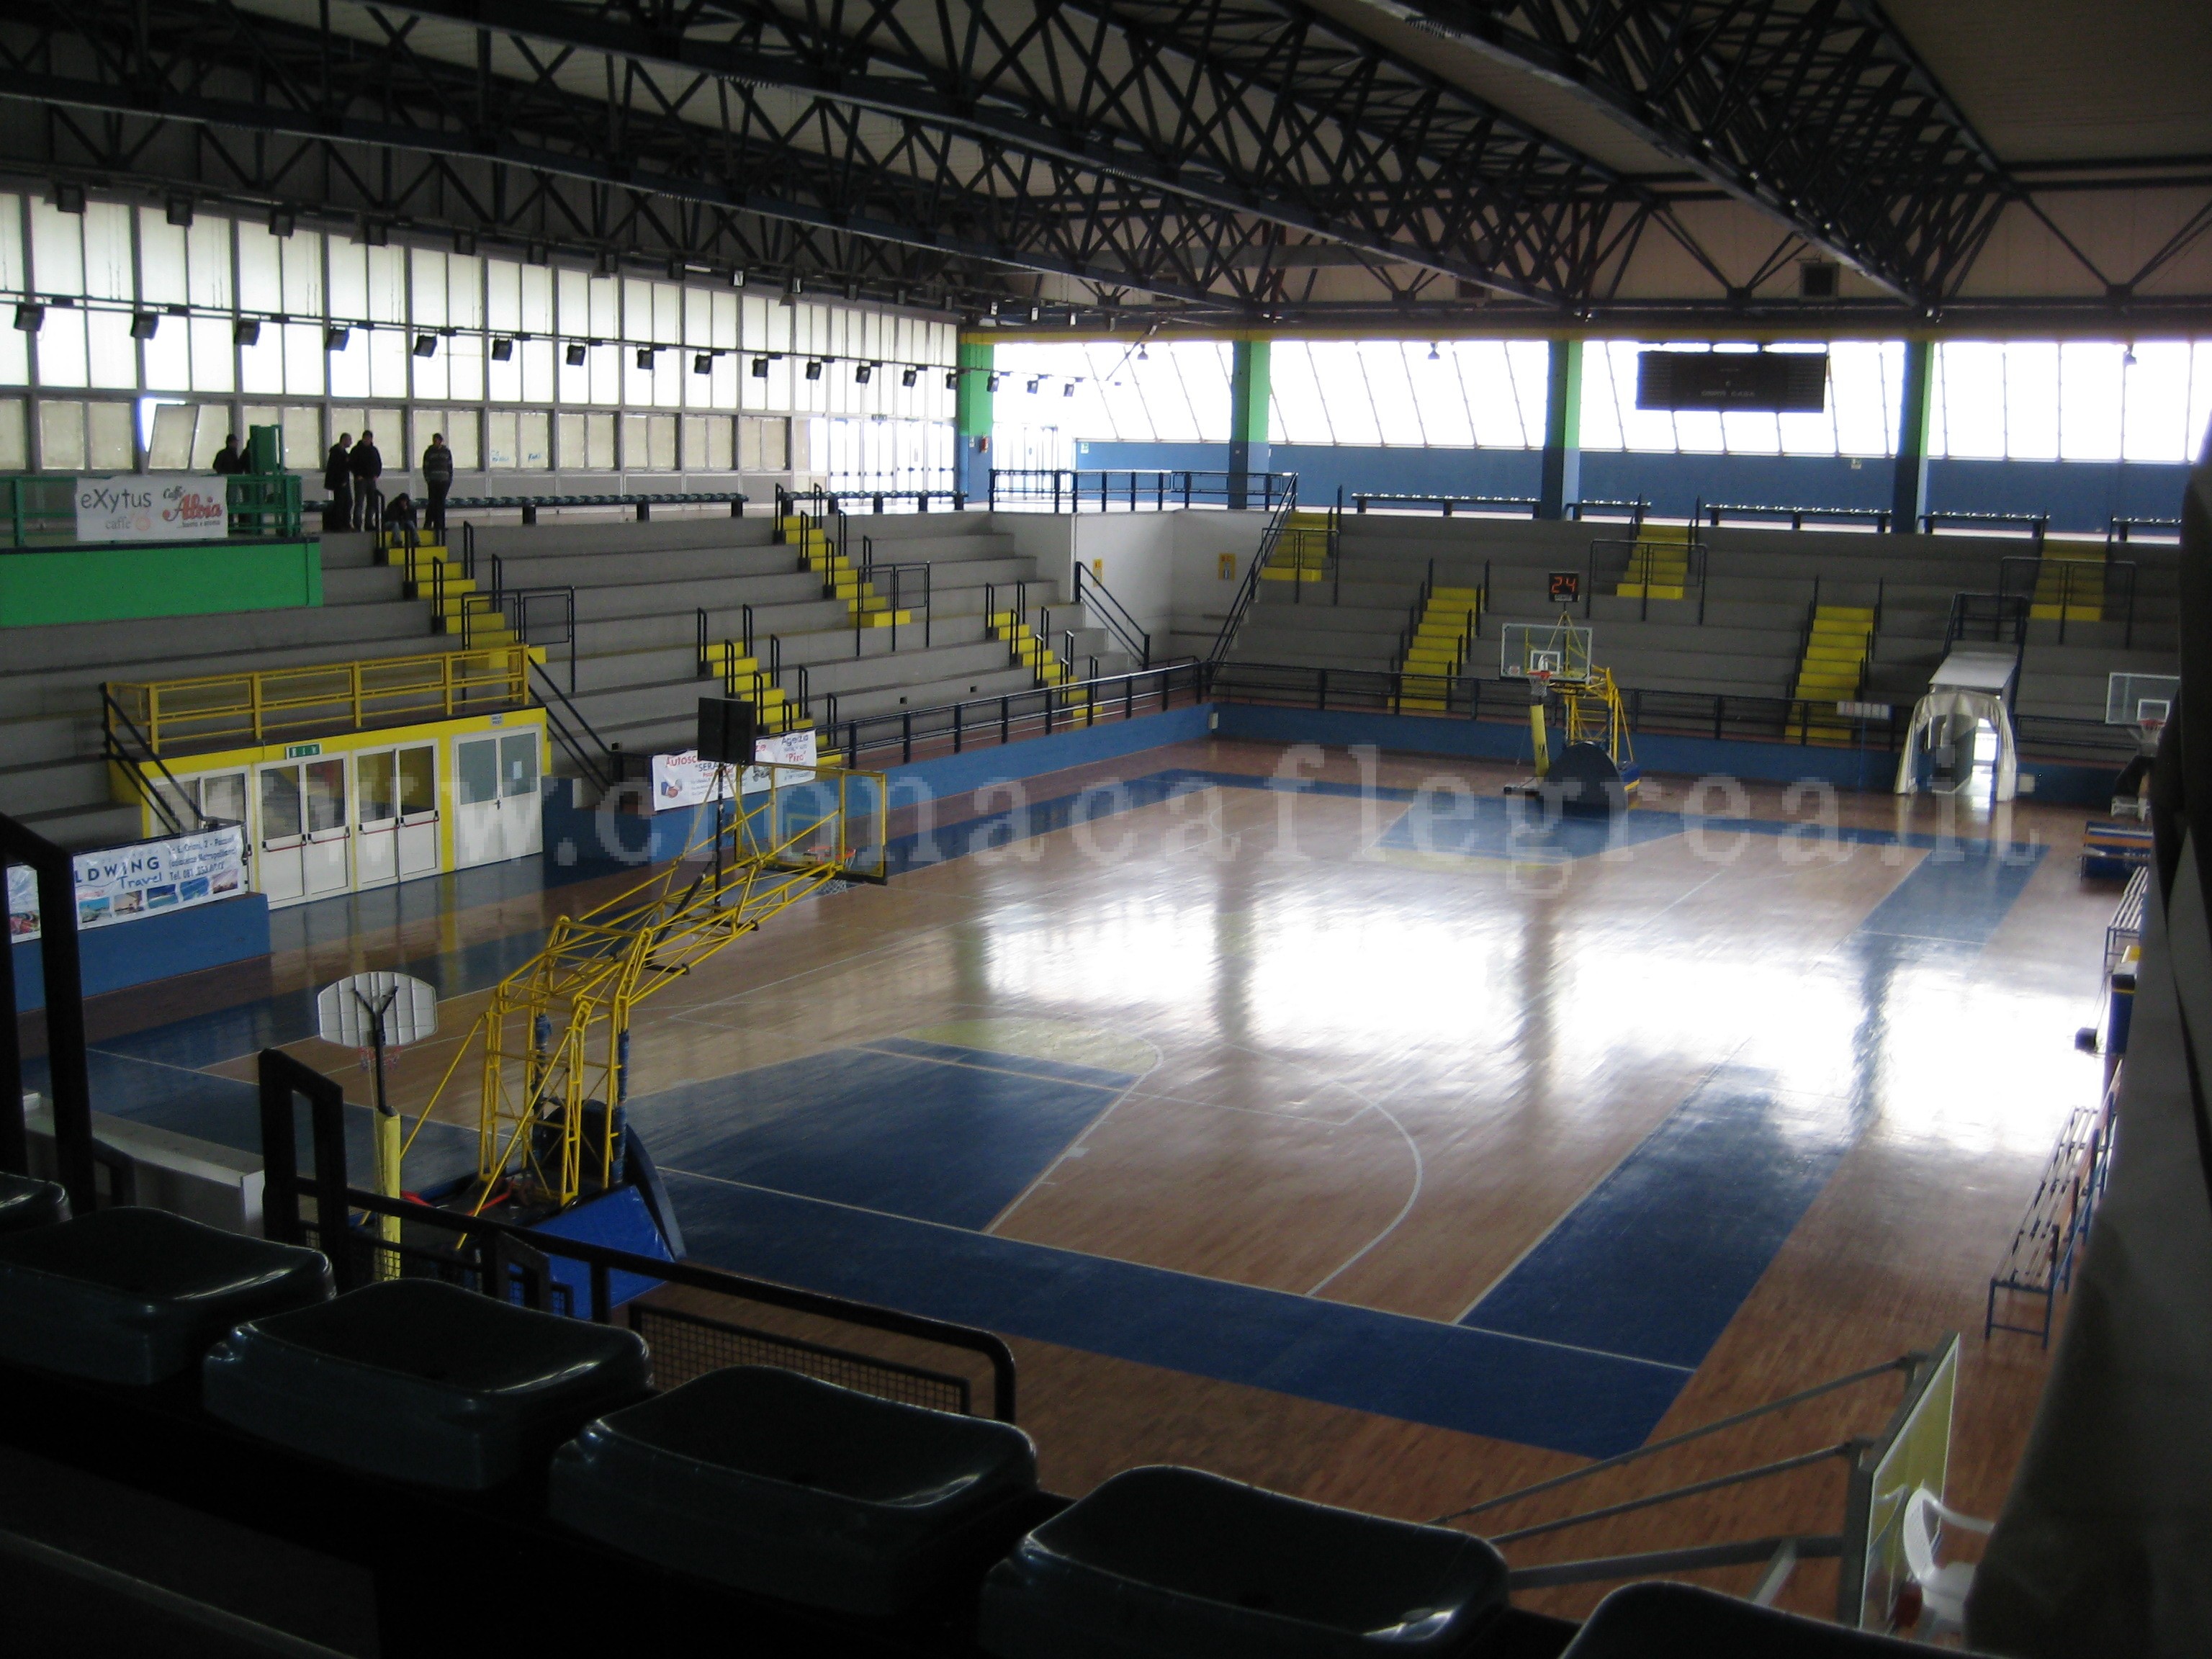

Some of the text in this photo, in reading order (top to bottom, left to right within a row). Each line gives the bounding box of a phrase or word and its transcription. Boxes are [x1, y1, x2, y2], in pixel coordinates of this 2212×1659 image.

[81, 487, 152, 513] eXytus
[1550, 575, 1577, 594] 24
[666, 755, 698, 768] Autosc
[74, 856, 160, 884] LDWING
[117, 872, 163, 889] Travel
